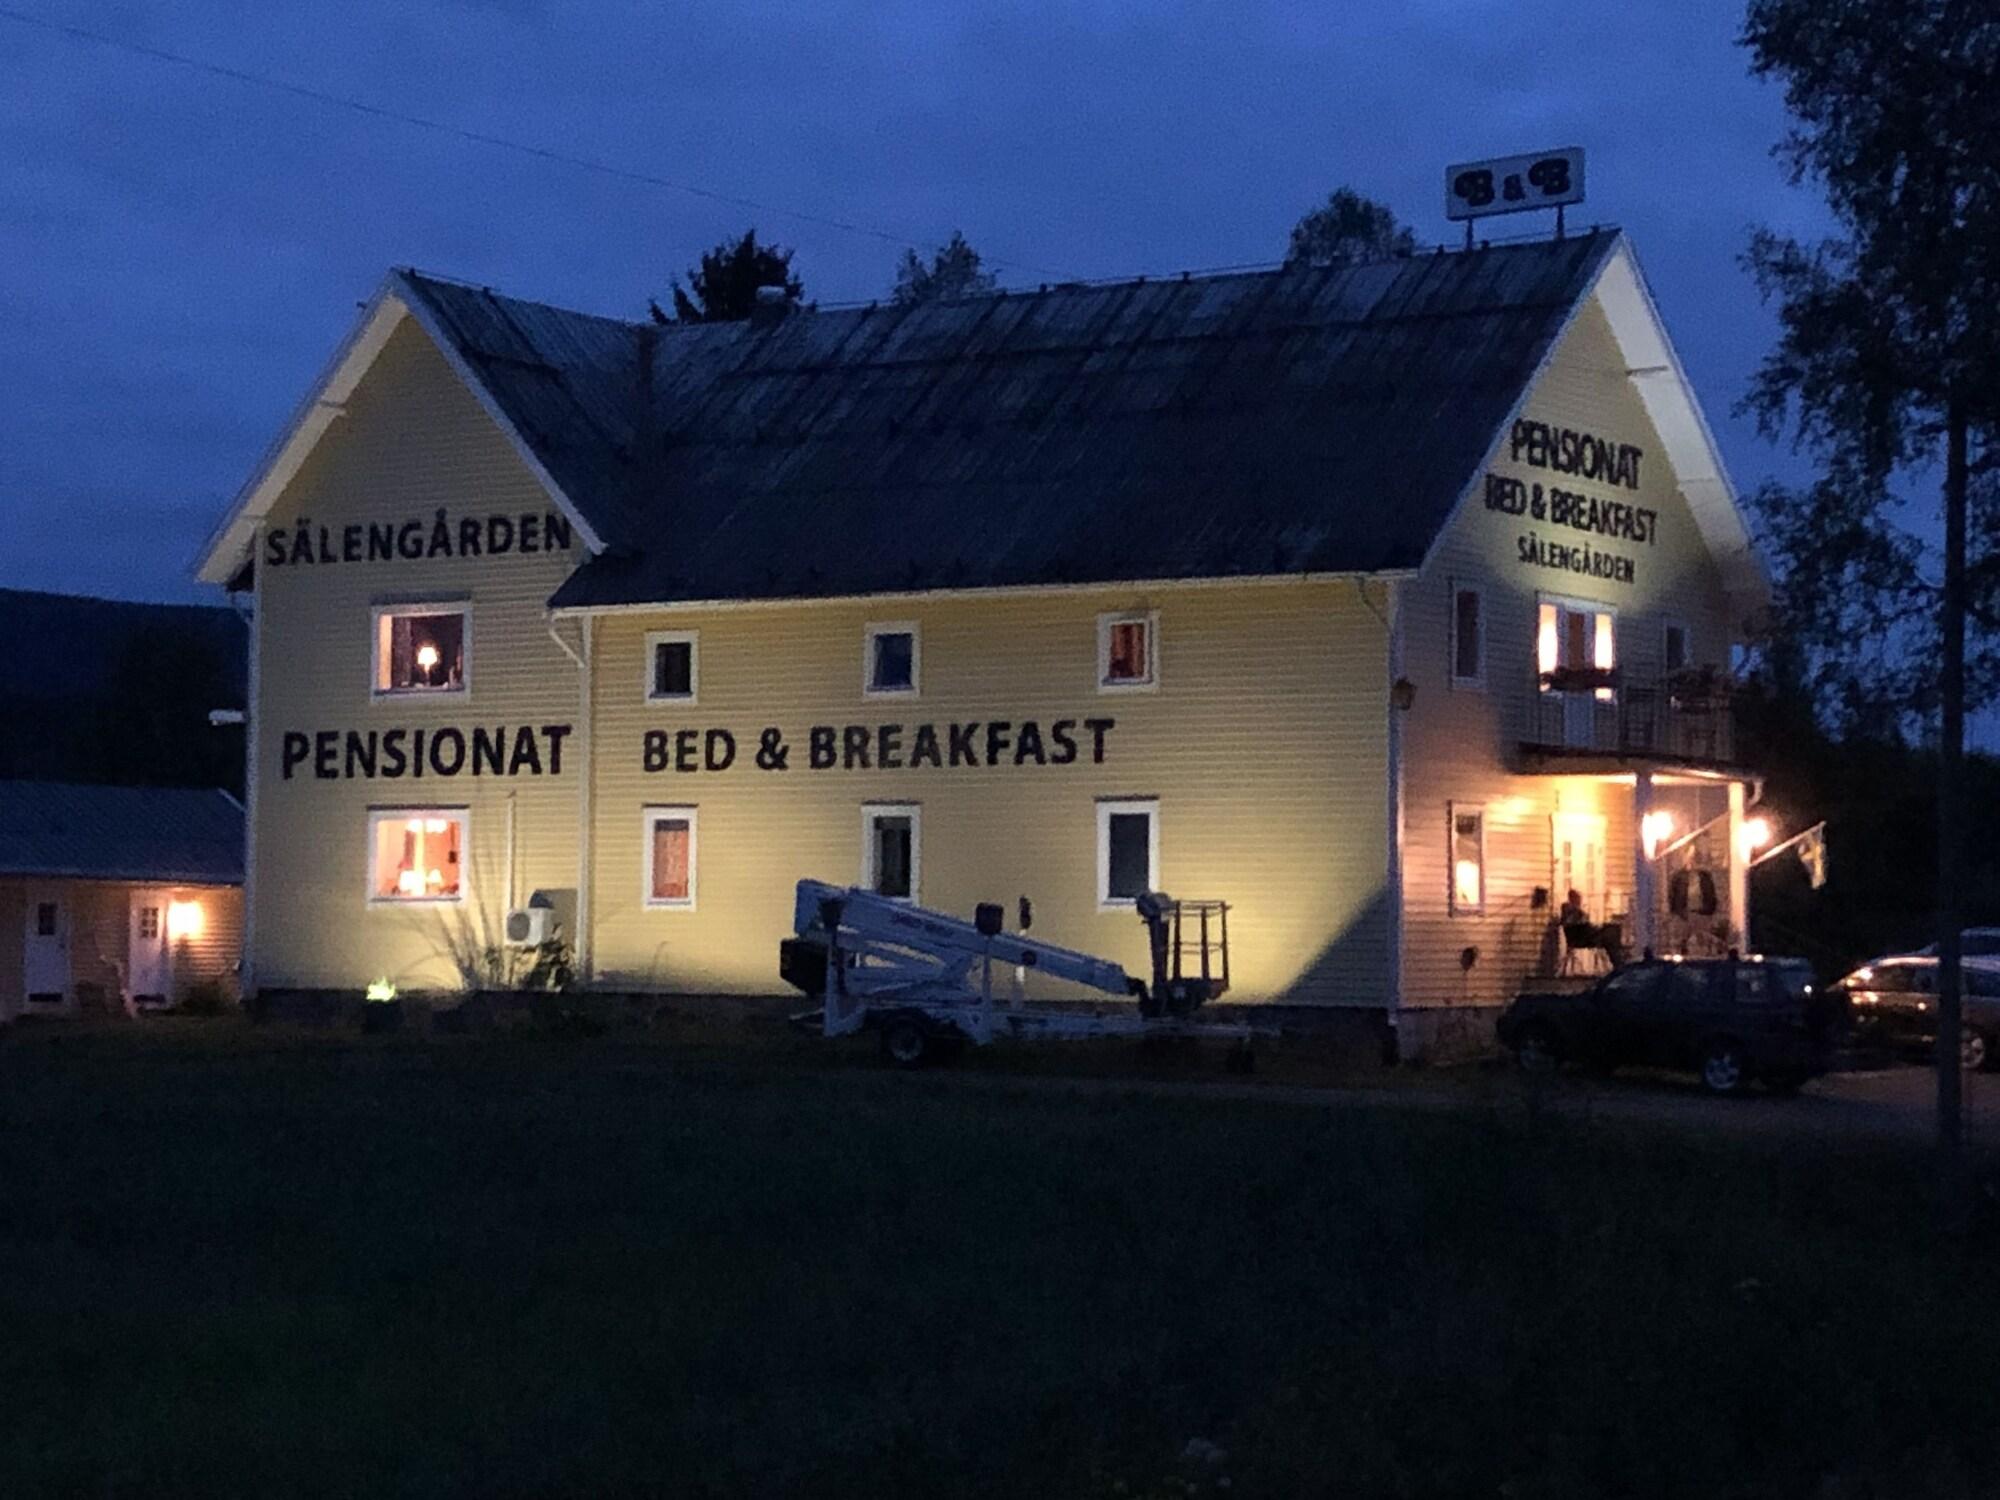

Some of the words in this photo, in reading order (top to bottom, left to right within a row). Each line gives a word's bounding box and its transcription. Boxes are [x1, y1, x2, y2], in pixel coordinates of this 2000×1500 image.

[1511, 418, 1643, 490] PENSIONAT
[267, 507, 571, 566] SÄLENGÅRDEN
[1484, 474, 1527, 516] BED
[1531, 483, 1546, 520] &
[1550, 487, 1657, 545] BREAKFAST
[283, 724, 573, 780] PENSIONAT
[643, 729, 736, 773] BED
[755, 727, 790, 770] &
[809, 718, 1115, 770] BREAKFAST
